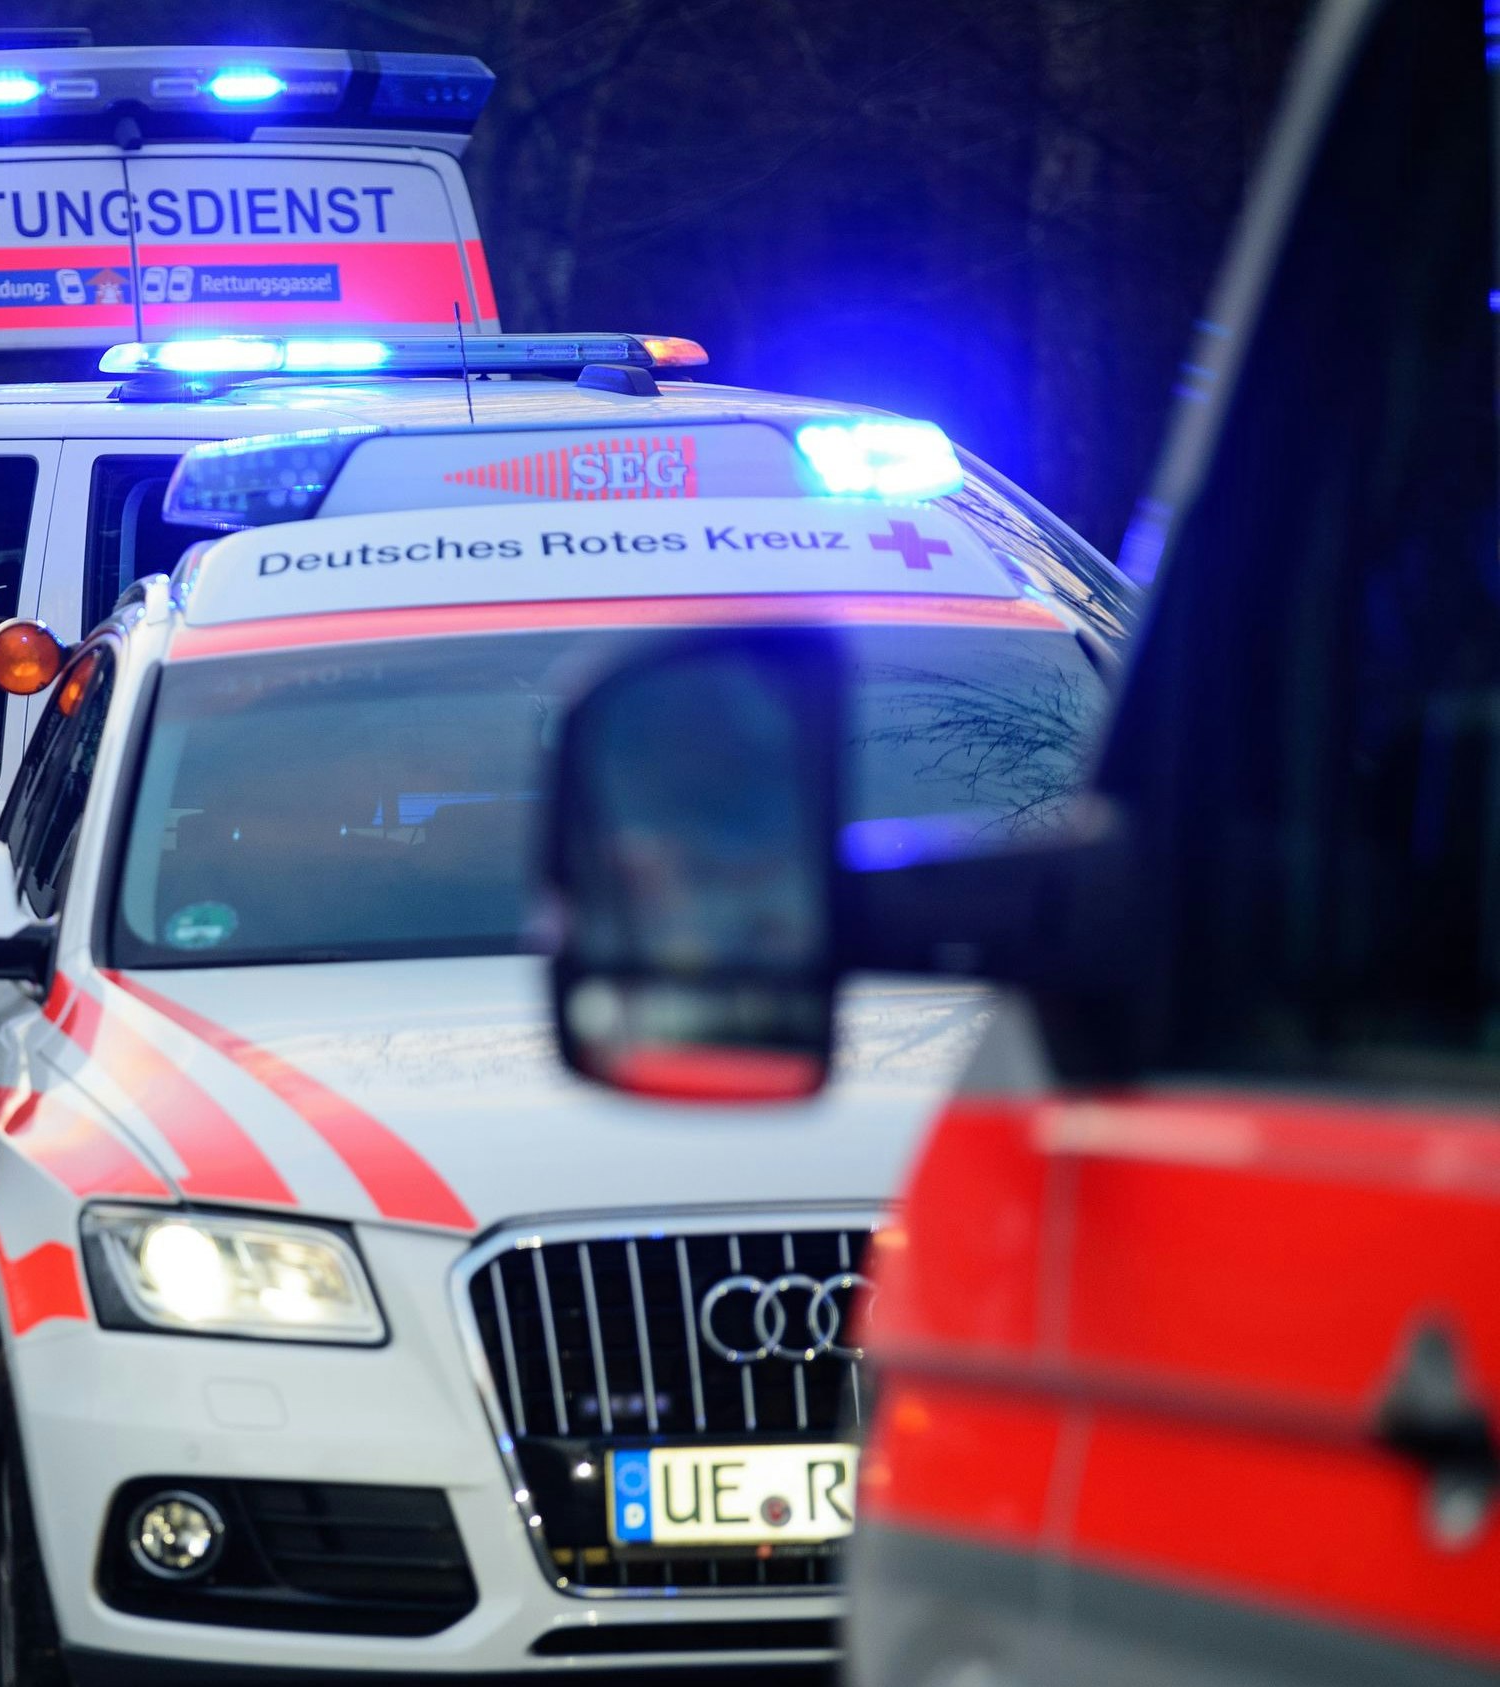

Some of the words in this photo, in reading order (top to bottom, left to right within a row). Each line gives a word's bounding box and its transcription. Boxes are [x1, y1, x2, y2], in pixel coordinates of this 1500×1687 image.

[200, 271, 333, 297] Rettungsgasse!
[571, 449, 688, 490] SEG
[258, 535, 525, 577] Deutsches
[540, 530, 689, 557] Rotes
[703, 525, 851, 551] Kreuz
[663, 1462, 751, 1524] UE
[806, 1460, 854, 1523] R
